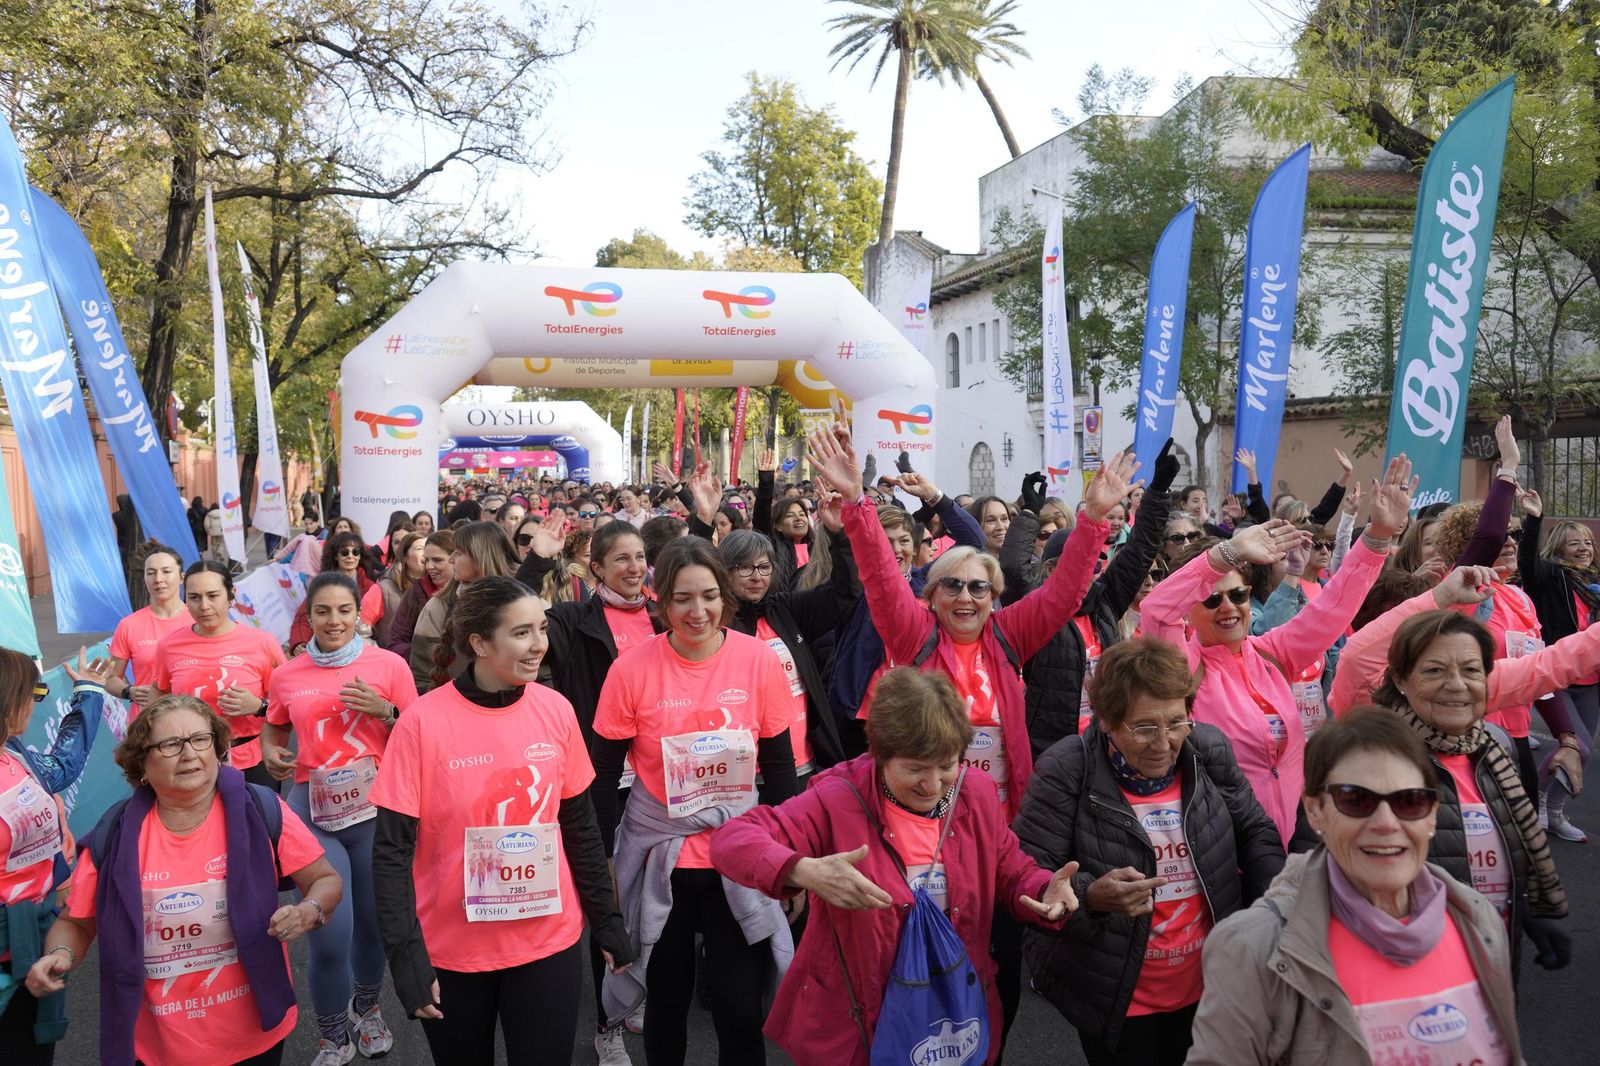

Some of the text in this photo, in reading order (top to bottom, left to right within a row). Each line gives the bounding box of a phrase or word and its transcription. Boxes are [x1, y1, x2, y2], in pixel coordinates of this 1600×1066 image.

[1402, 164, 1484, 445] Batiste
[544, 323, 623, 337] TotalEnergies
[703, 326, 776, 338] TotalEnergies
[1244, 263, 1288, 412] Marlene
[575, 366, 626, 376] de Deportes
[1144, 304, 1176, 432] Marlene
[467, 408, 555, 427] OYSHO
[353, 446, 423, 457] TotalEnergies
[352, 496, 421, 505] totalenergies.es
[656, 698, 692, 709] OYSHO
[449, 753, 494, 770] OYSHO
[696, 762, 727, 779] 016
[332, 788, 360, 804] 016
[34, 807, 53, 828] 016
[500, 841, 536, 849] ASTURIANA
[500, 864, 536, 881] 016
[1164, 865, 1178, 874] 639
[509, 886, 527, 894] 7383
[158, 900, 201, 911] ASTURIANA
[475, 907, 508, 915] OYSHO
[526, 903, 551, 912] Santander
[160, 923, 203, 941] 016
[171, 943, 192, 952] 3719
[179, 950, 198, 959] MUJER
[201, 946, 222, 955] SEVILLA
[192, 956, 226, 967] Santander
[185, 998, 199, 1010] DE
[201, 996, 214, 1008] LA
[216, 984, 250, 1005] MUJER
[187, 1009, 206, 1019] 2025
[1371, 1030, 1406, 1044] SUMA
